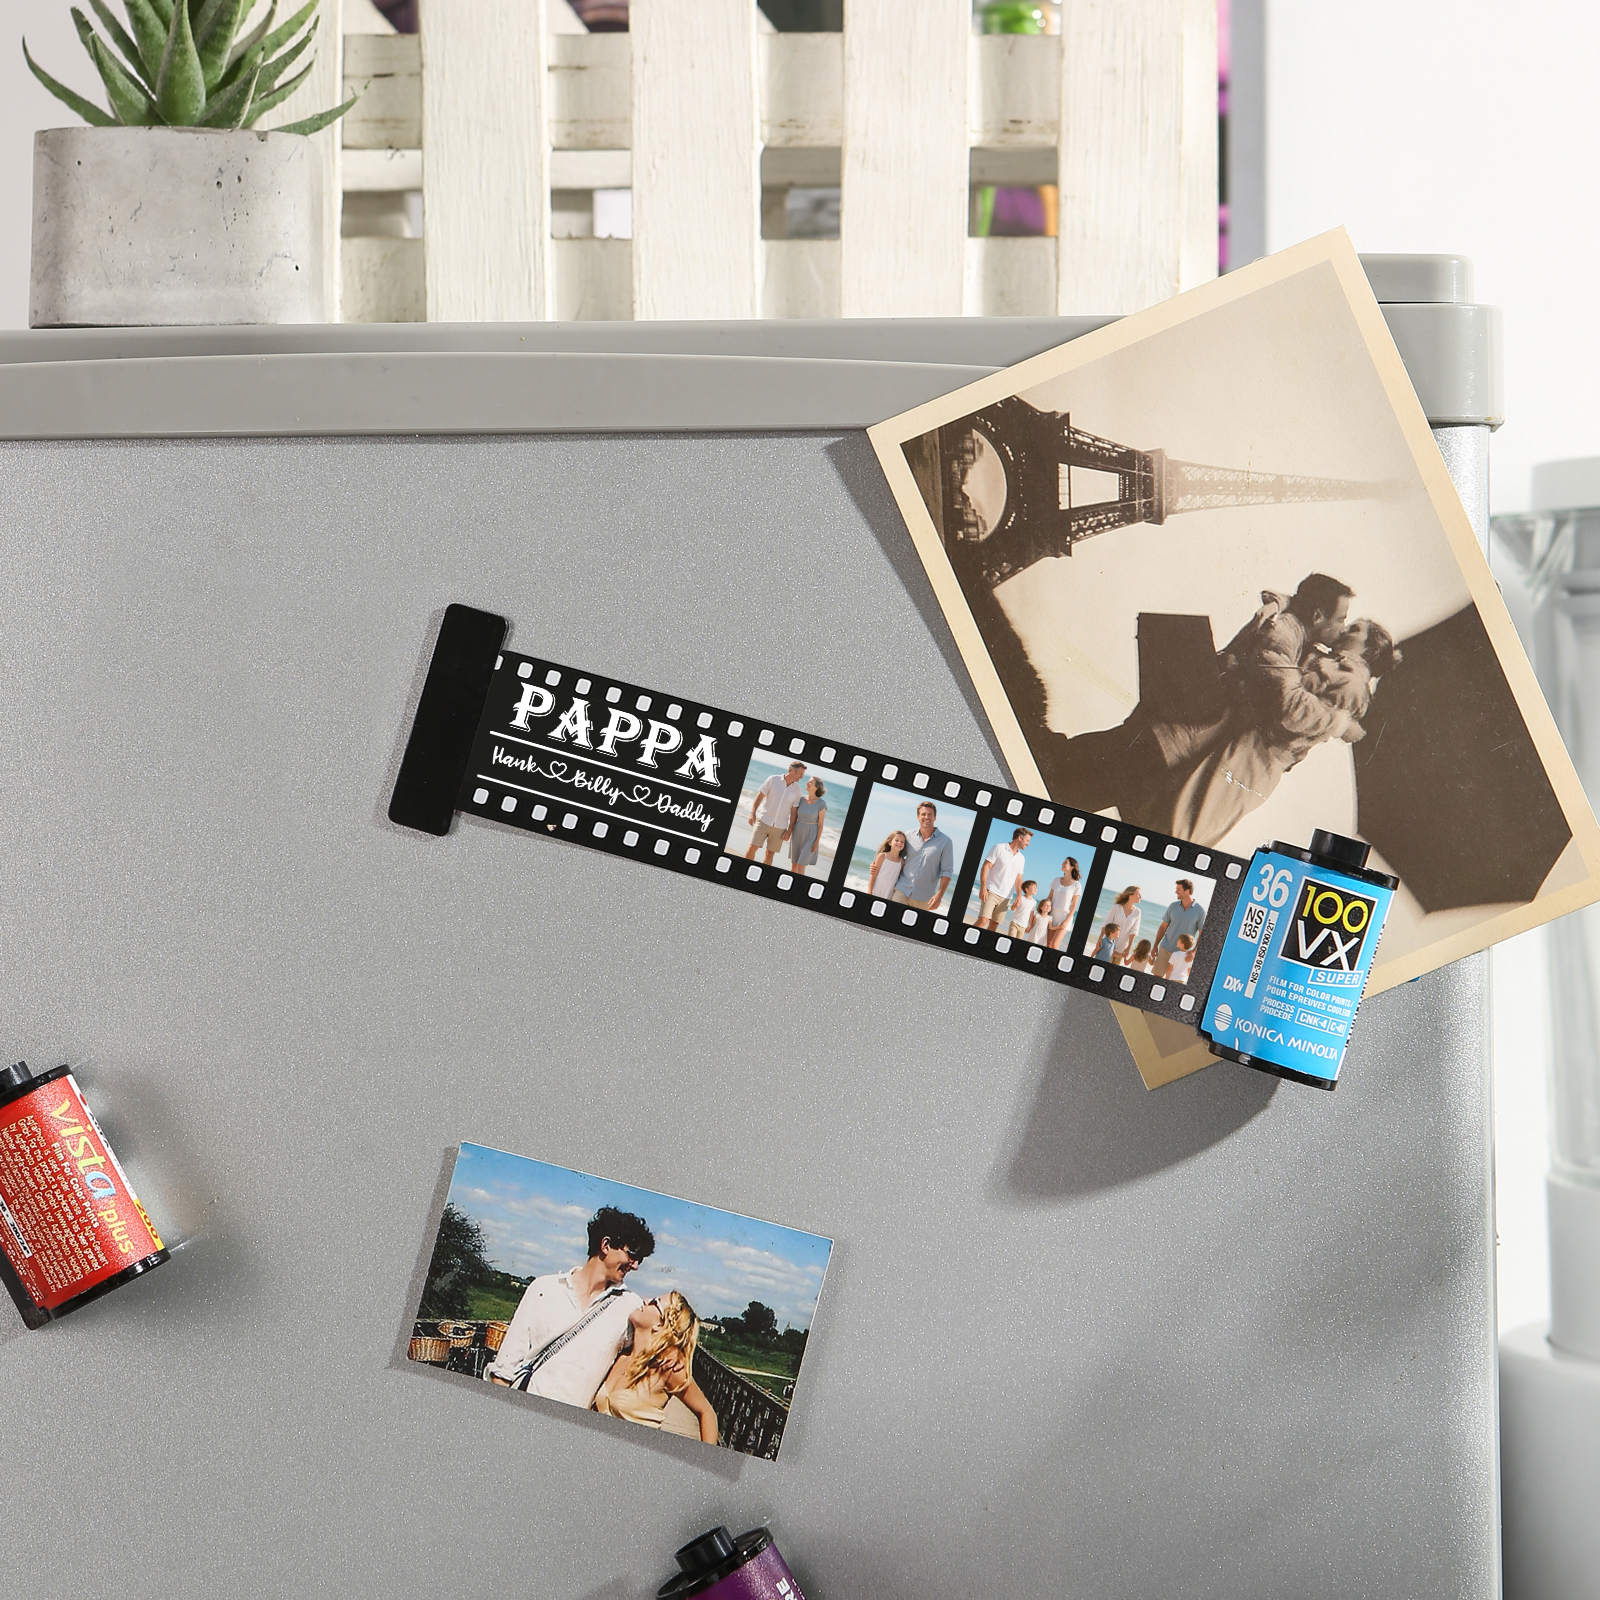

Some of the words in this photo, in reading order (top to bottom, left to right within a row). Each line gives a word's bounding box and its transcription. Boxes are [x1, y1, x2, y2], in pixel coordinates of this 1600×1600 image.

[509, 682, 721, 787] PAPPA
[492, 746, 539, 772] Hank
[572, 769, 619, 805] Billy
[657, 793, 714, 832] Daddy
[1252, 863, 1293, 908] 36
[1245, 907, 1265, 923] NS
[1302, 885, 1369, 934] 100
[1243, 923, 1258, 939] 135
[1297, 919, 1360, 972] VX
[1269, 975, 1287, 988] FILM
[1288, 980, 1304, 994] FOR
[1305, 985, 1330, 1000] COLOR
[1316, 971, 1360, 984] SUPER
[1262, 997, 1295, 1013] PROCESS
[1266, 985, 1286, 998] POUR
[1288, 991, 1326, 1010] EPREUVES
[1260, 1005, 1292, 1022] PROCEDE
[1300, 1013, 1327, 1028] CNK-4
[1235, 1017, 1284, 1045] KONICA
[1287, 1037, 1338, 1060] MINOLTA
[0, 1127, 18, 1152] Neither
[8, 1122, 19, 1134] by
[24, 1113, 49, 1149] AgfaPhoto
[13, 1132, 37, 1167] AgfaPhoto
[27, 1137, 39, 1150] For
[33, 1148, 45, 1162] this
[43, 1148, 51, 1156] is
[2, 1149, 27, 1188] manufacture
[11, 1150, 39, 1193] Agfa-Gevaert
[38, 1160, 56, 1185] product
[47, 1156, 61, 1174] used
[49, 1097, 117, 1200] vista
[97, 1208, 135, 1254] plus
[30, 1165, 49, 1191] Holding
[51, 1141, 66, 1162] Film
[60, 1161, 75, 1178] For
[69, 1176, 87, 1202] Color
[81, 1200, 101, 1229] Prints
[56, 1173, 71, 1193] under
[21, 1186, 32, 1200] this
[33, 1191, 50, 1212] GmbH
[44, 1189, 60, 1211] GmbH
[66, 1192, 83, 1216] license
[0, 1174, 16, 1199] contact
[11, 1198, 22, 1211] the
[18, 1210, 39, 1242] distributor
[27, 1197, 44, 1222] product
[44, 1210, 56, 1224] nor
[78, 1215, 89, 1225] of
[39, 1219, 48, 1228] or
[70, 1219, 82, 1233] has
[136, 1202, 160, 1240] 200
[8, 1203, 26, 1233] Produced
[22, 1231, 31, 1242] for
[27, 1241, 37, 1254] and
[49, 1284, 58, 1294] by
[17, 1192, 28, 1205] For
[33, 1225, 50, 1250] support
[45, 1248, 57, 1262] and
[51, 1259, 70, 1288] warranty
[43, 1226, 59, 1250] provide
[49, 1222, 73, 1257] AgfaPhoto
[76, 1231, 90, 1248] been
[82, 1224, 110, 1268] Agfa-Gevaert
[53, 1248, 65, 1262] any
[83, 1246, 102, 1272] granted
[60, 1259, 77, 1284] product
[67, 1255, 85, 1281] Holding
